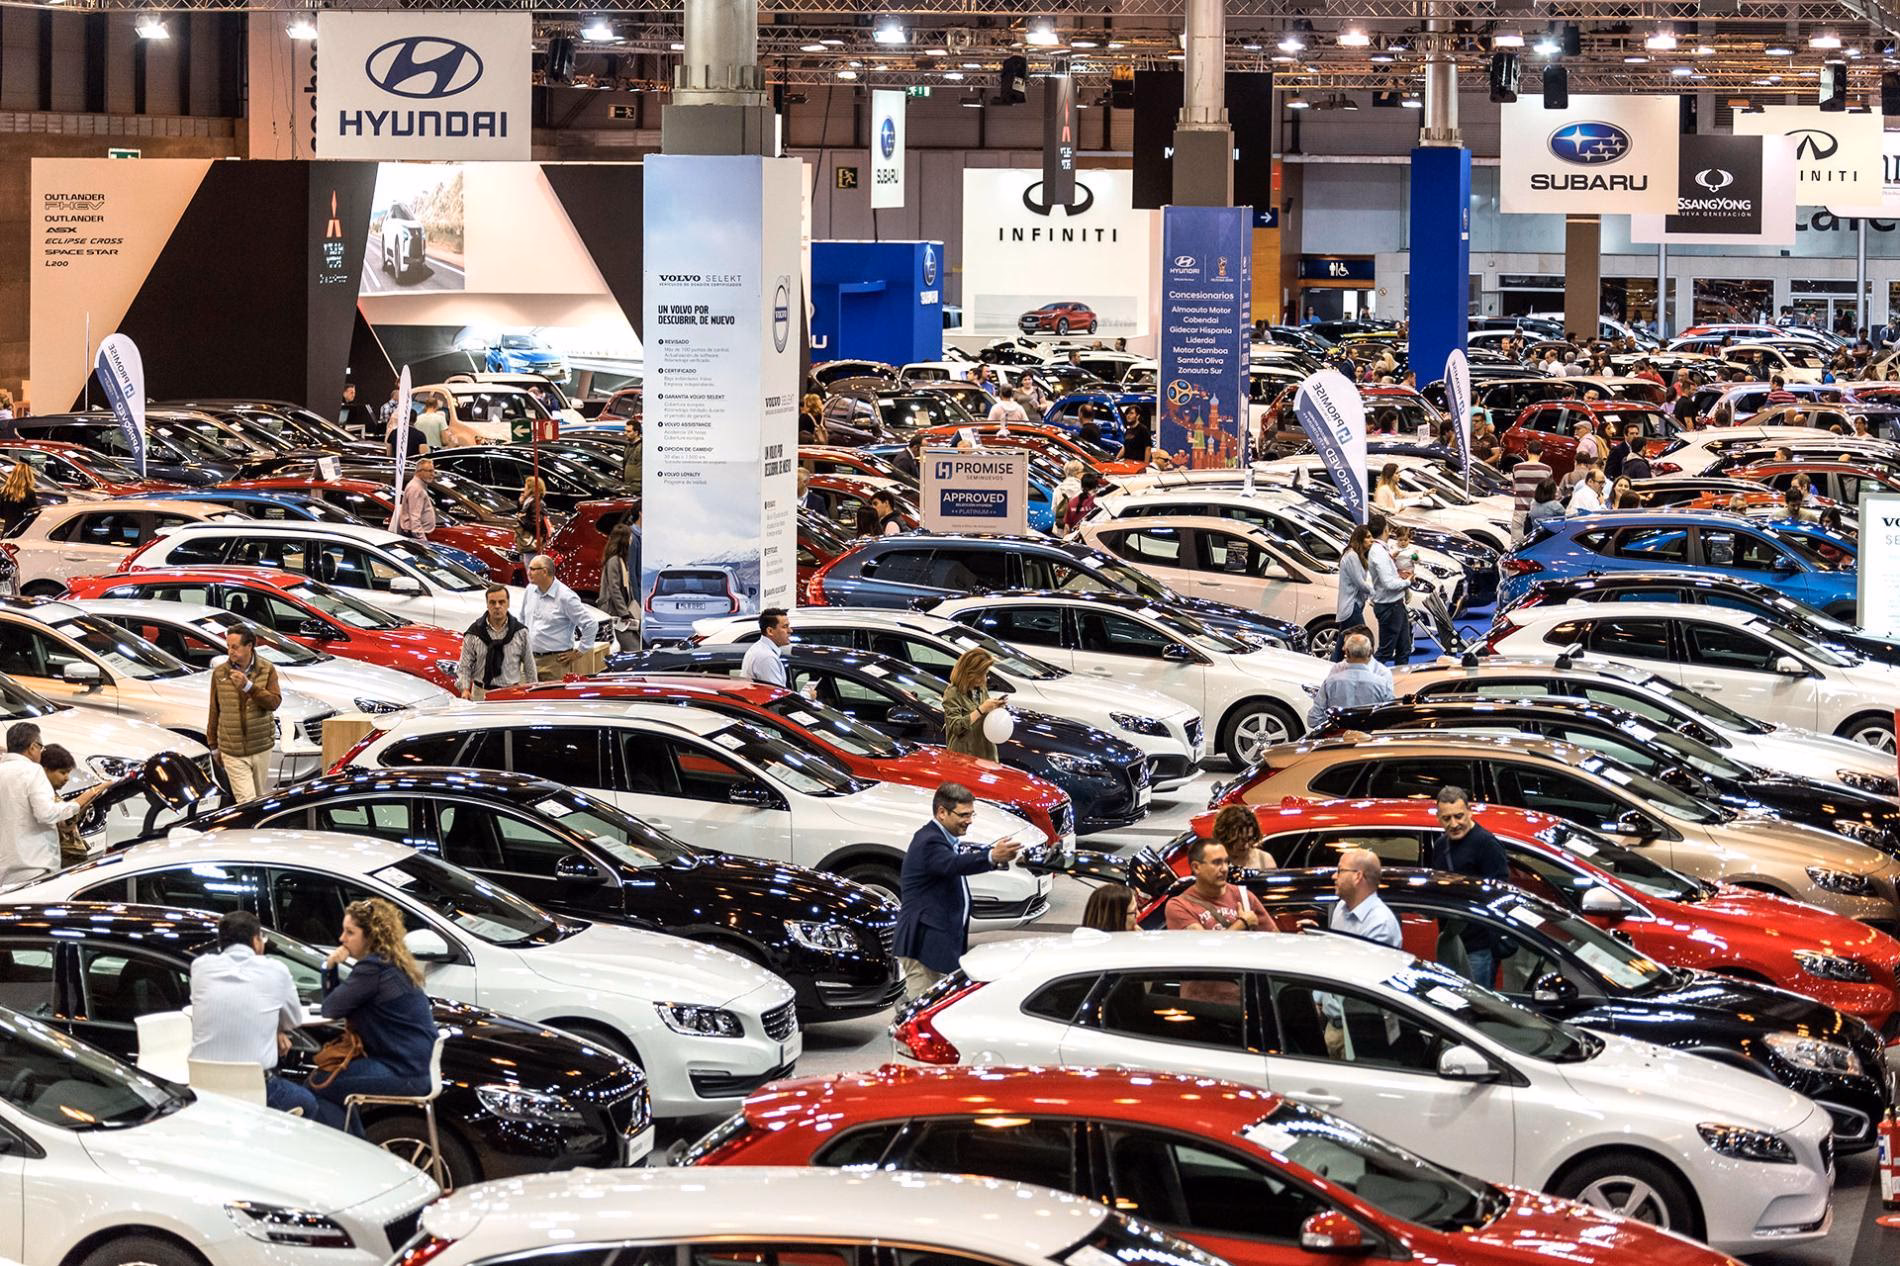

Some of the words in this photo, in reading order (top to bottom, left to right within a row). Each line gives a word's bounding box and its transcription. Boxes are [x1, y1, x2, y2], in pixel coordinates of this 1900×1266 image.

[339, 110, 508, 138] HYUNDAI
[1800, 170, 1857, 182] INITI
[1530, 174, 1648, 191] SUBARU
[44, 193, 105, 201] OUTLANDER
[44, 202, 105, 211] PHEV
[999, 227, 1117, 242] INFINITI
[658, 274, 701, 282] VOLVO
[705, 274, 742, 282] SELEKT
[1168, 290, 1234, 300] Concesionarios
[658, 305, 669, 315] UN
[670, 305, 693, 315] VOLVO
[694, 305, 709, 315] POR
[1208, 306, 1232, 314] Motor
[658, 315, 698, 326] DESCUBRIR,
[699, 316, 709, 325] DE
[710, 316, 735, 325] NUEVO
[1183, 316, 1219, 324] Cobendai
[1199, 326, 1232, 335] Hispania
[1185, 336, 1216, 344] Liderdai
[1196, 346, 1228, 354] Gamboa
[1177, 356, 1203, 364] Santón
[1178, 366, 1209, 374] Zonauto
[955, 463, 1014, 475] PROMISE
[943, 493, 1005, 503] APPROVED
